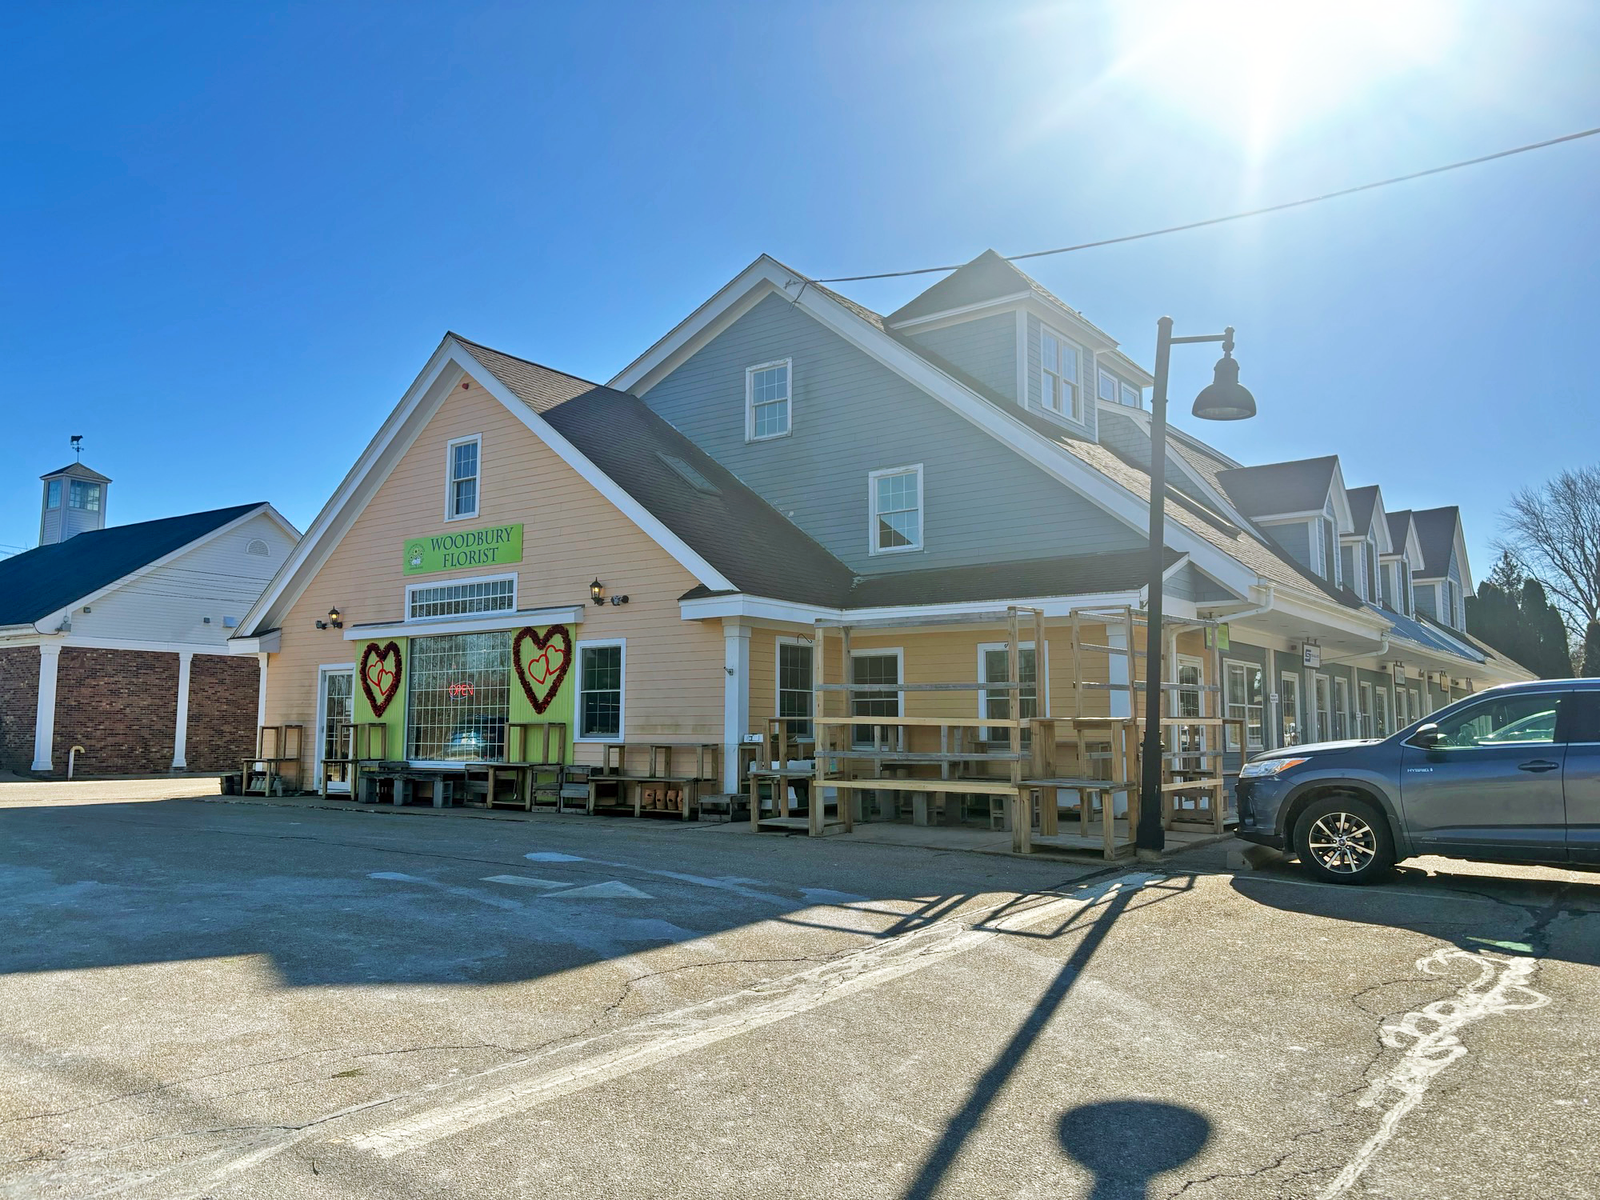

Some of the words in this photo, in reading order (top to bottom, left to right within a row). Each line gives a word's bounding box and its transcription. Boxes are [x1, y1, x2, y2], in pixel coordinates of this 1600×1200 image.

[431, 527, 514, 552] WOODBURY
[443, 547, 499, 568] FLORIST
[449, 684, 474, 696] OPEN
